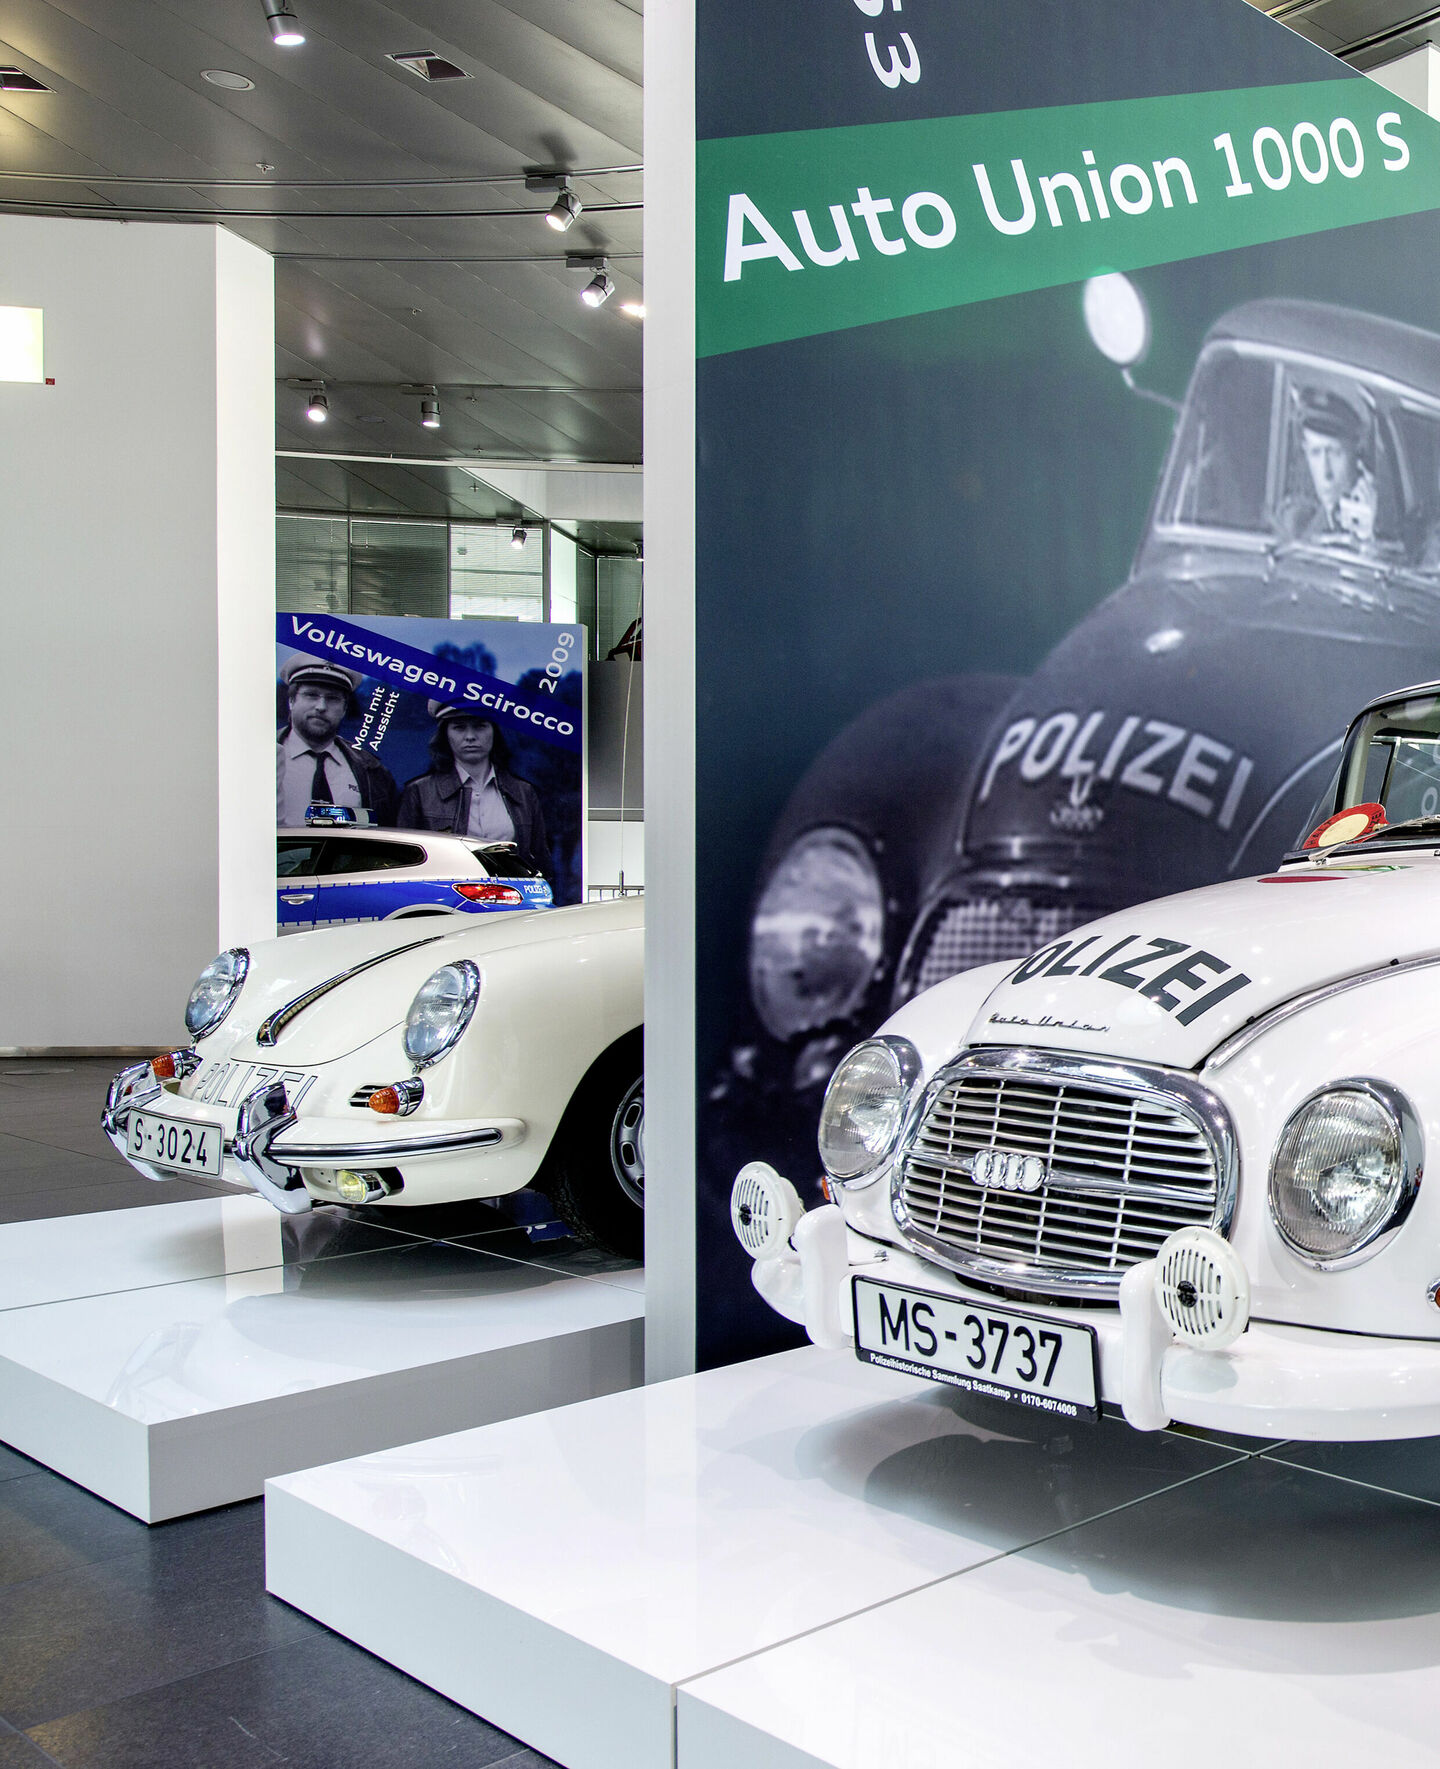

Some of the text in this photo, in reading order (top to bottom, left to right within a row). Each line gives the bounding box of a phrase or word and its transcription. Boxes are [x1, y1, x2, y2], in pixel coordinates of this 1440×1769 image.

[723, 111, 1411, 283] Auto Union 1000 S
[291, 616, 575, 736] Volkswagen Scirocco
[538, 632, 575, 694] 2009
[351, 686, 386, 750] Mord mit
[368, 691, 400, 752] Aussicht
[980, 711, 1253, 830] POLIZEI
[1010, 934, 1252, 1027] OLIZEI
[134, 1117, 207, 1167] S-3024
[879, 1293, 1063, 1388] MS-3737
[870, 1352, 1078, 1417] Polizeihistorische Sammlung Saatkamp 0170-6074008
